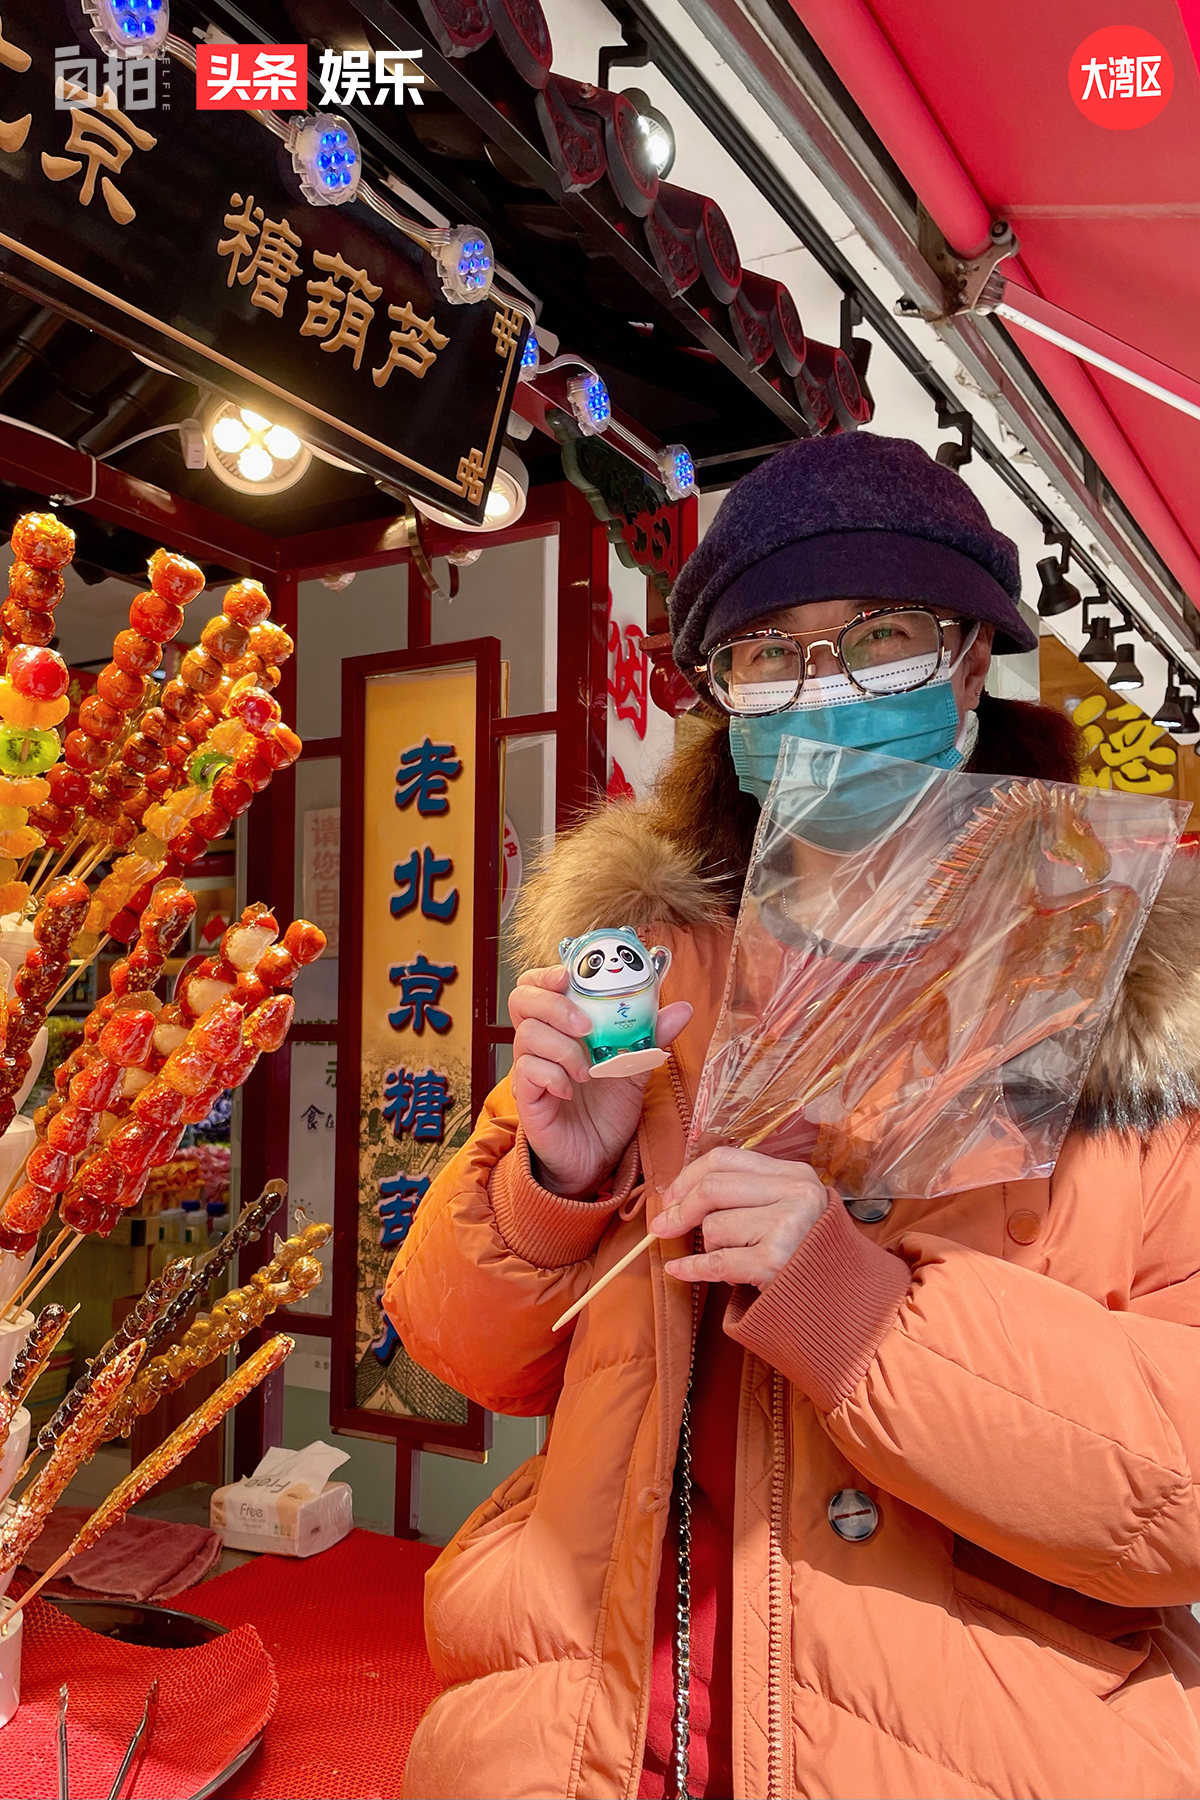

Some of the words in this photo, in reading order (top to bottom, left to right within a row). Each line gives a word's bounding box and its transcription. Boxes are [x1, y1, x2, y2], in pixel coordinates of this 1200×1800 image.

[217, 192, 450, 388] 糖葫芦
[240, 1503, 263, 1518] Free
